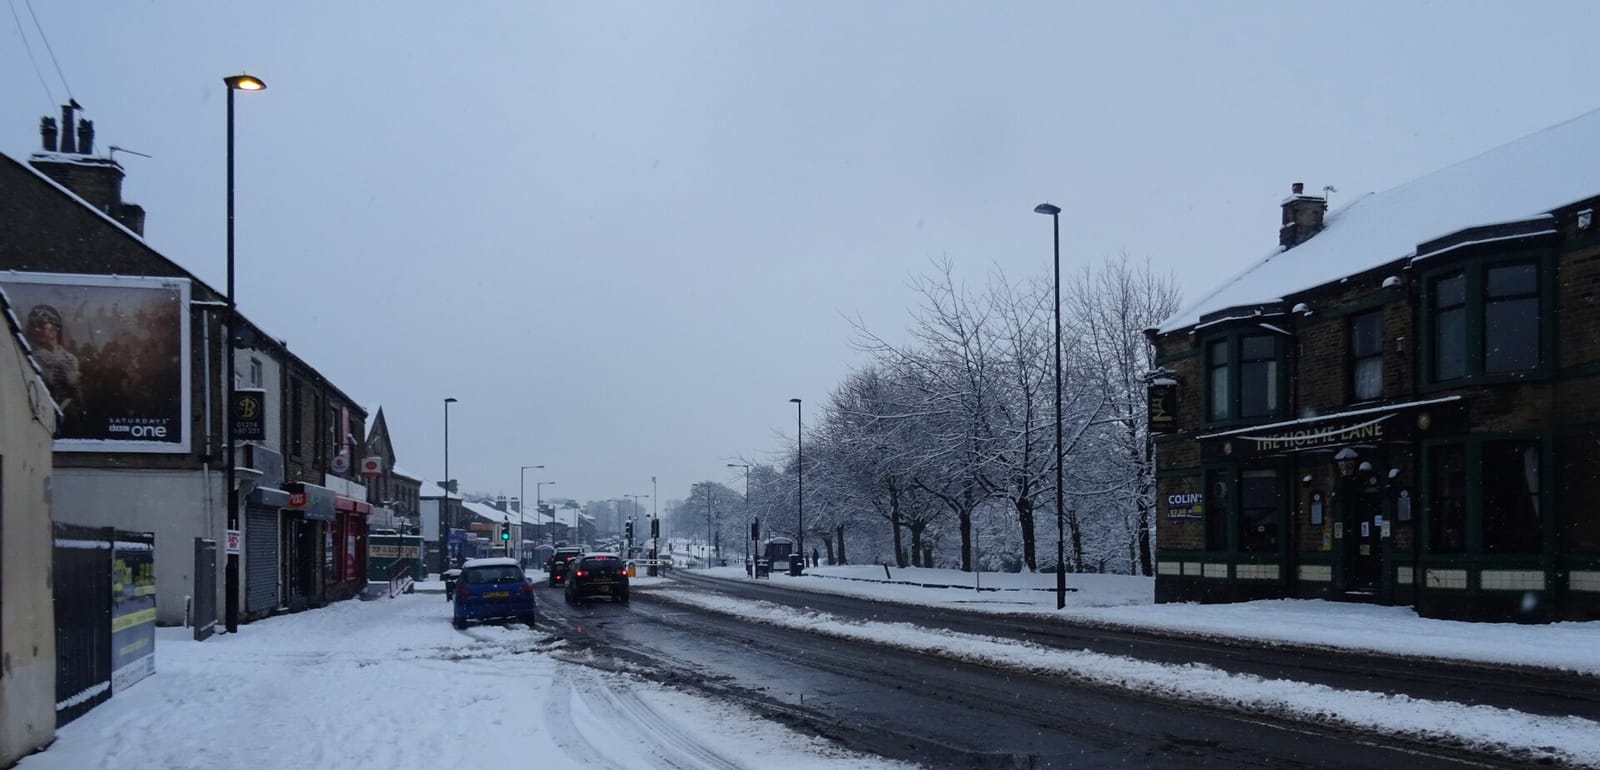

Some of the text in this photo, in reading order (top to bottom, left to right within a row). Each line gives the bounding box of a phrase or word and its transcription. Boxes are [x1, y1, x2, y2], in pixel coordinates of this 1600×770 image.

[1256, 422, 1384, 451] THE HOLME LANE
